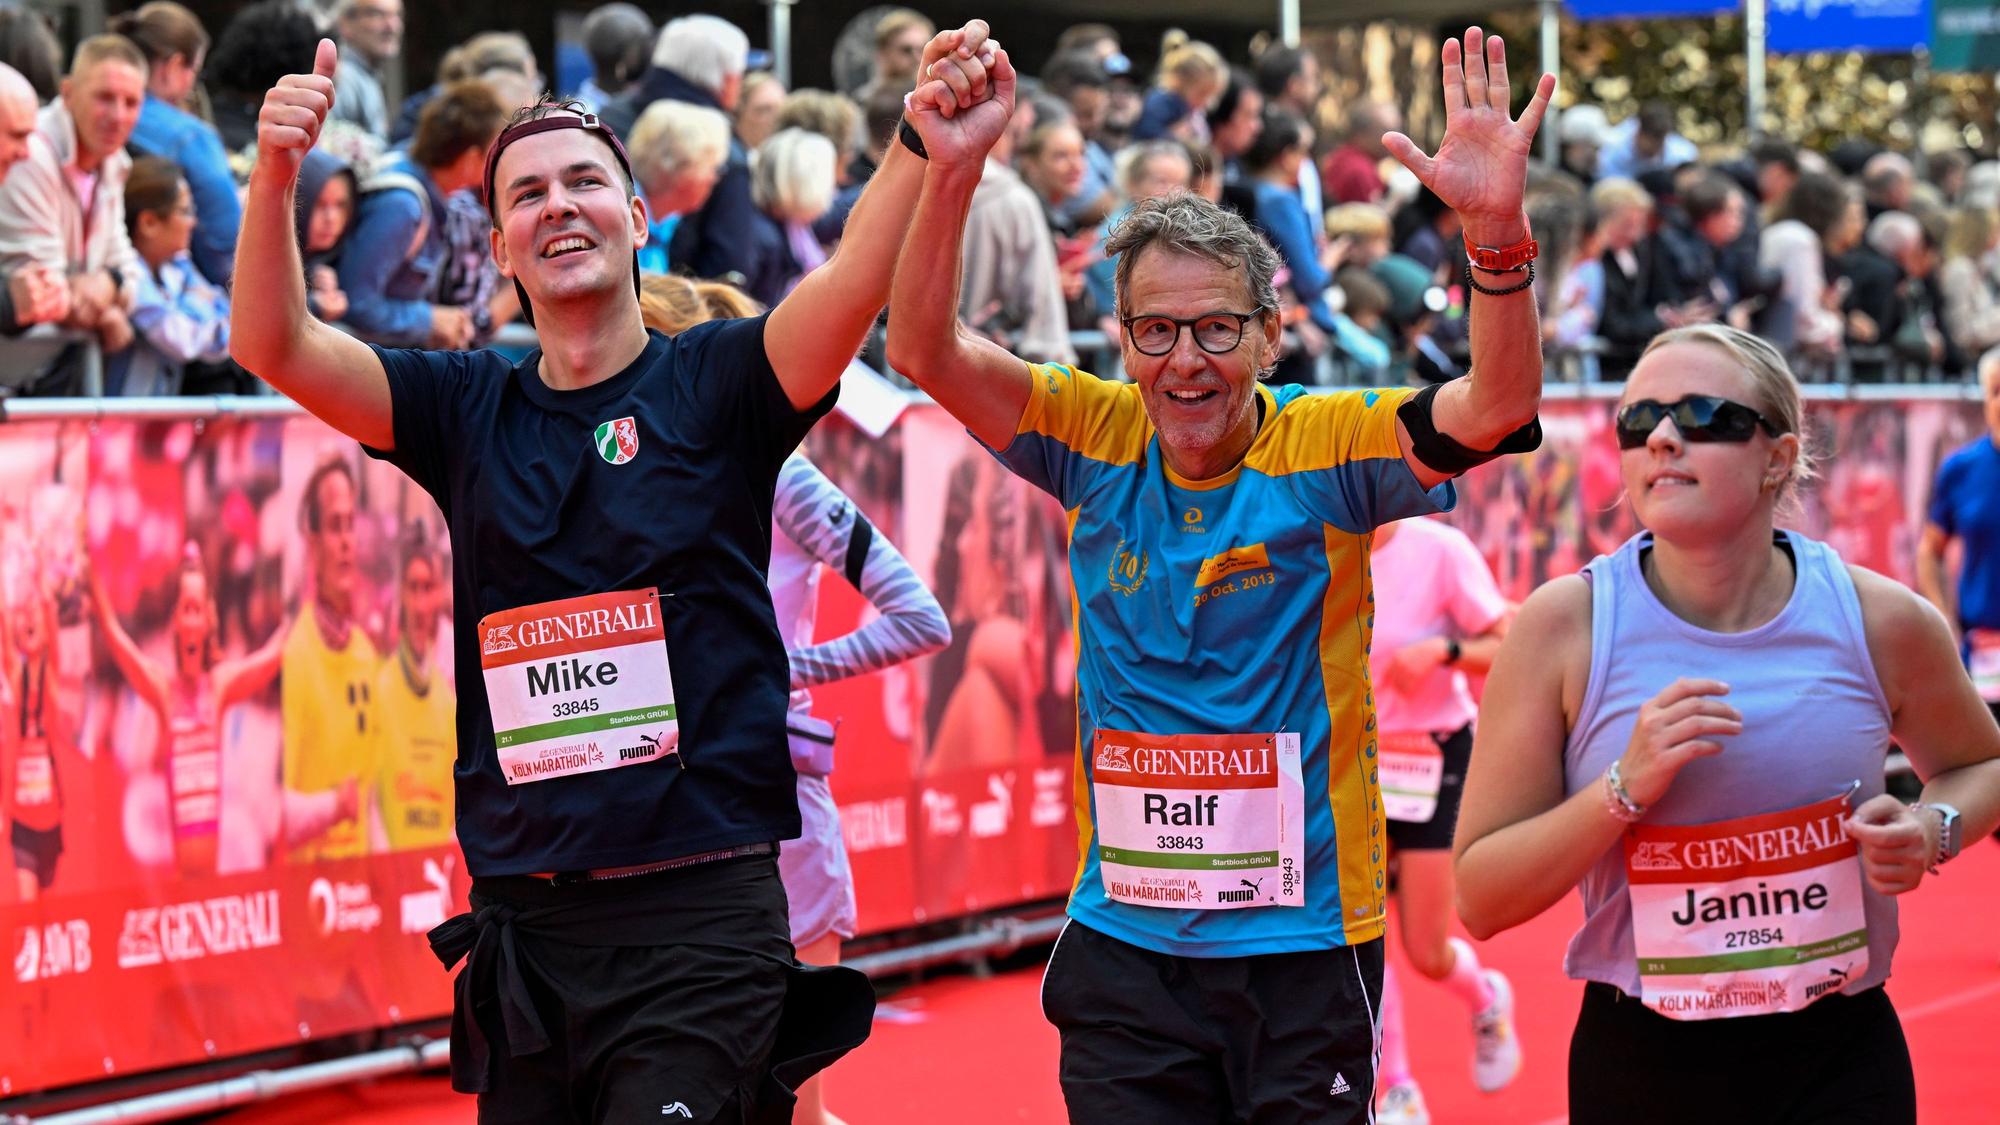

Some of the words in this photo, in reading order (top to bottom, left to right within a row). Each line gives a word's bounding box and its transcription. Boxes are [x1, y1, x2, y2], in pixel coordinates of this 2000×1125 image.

[1119, 551, 1138, 579] 10
[1193, 592, 1208, 607] 20
[1211, 582, 1239, 597] Oct.
[1242, 572, 1275, 590] 2013
[518, 602, 657, 647] GENERALI
[526, 658, 619, 698] Mike
[552, 697, 600, 718] 33845
[609, 712, 646, 726] Startblock
[647, 709, 669, 720] GRÜN
[549, 743, 585, 757] GENERALI
[619, 744, 656, 761] PUMA
[511, 762, 533, 778] KÖLN
[533, 752, 587, 775] MARATHON
[1133, 748, 1271, 777] GENERALI
[1144, 793, 1218, 827] Ralf
[1156, 835, 1204, 850] 33843
[1212, 858, 1248, 867] Startblock
[1250, 856, 1271, 865] GRÜN
[1150, 877, 1185, 887] GENERALI
[1283, 857, 1294, 896] 33843
[1111, 881, 1131, 897] KÖLN
[1133, 885, 1185, 902] MARATHON
[1218, 889, 1254, 903] PUMA
[1672, 882, 1828, 926] Janine
[160, 889, 281, 963] GENERALI
[1725, 927, 1784, 949] 27854
[1696, 990, 1766, 1011] MARATHON
